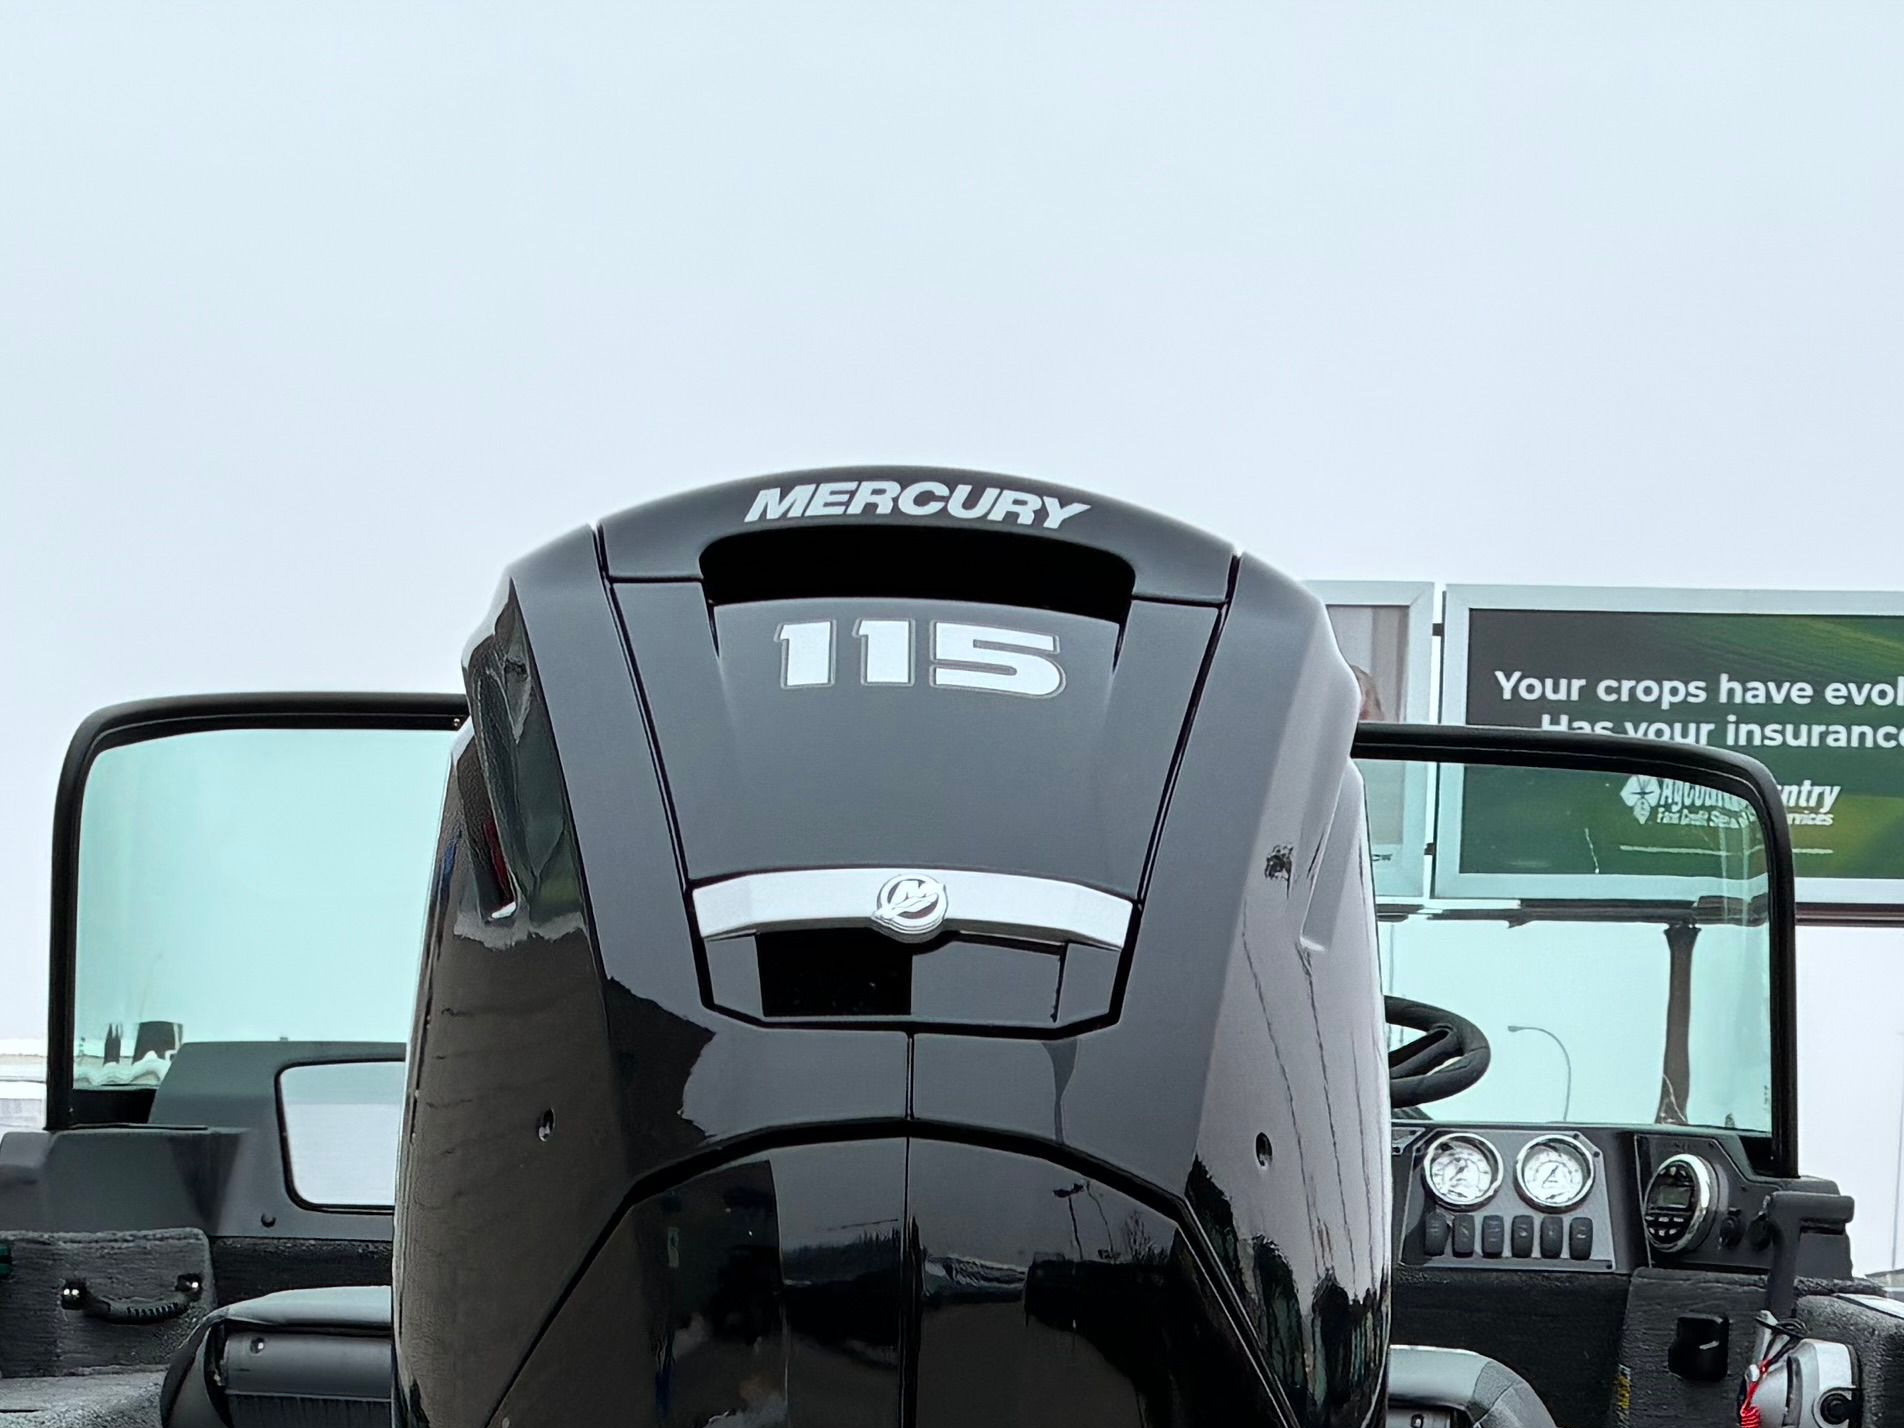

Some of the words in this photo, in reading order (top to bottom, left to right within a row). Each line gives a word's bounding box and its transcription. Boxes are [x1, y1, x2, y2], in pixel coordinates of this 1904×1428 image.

[744, 479, 1092, 530] MERCURY
[773, 618, 1066, 699] 115
[1494, 671, 1586, 701] Your
[1596, 678, 1707, 710] crops
[1719, 673, 1814, 705] have
